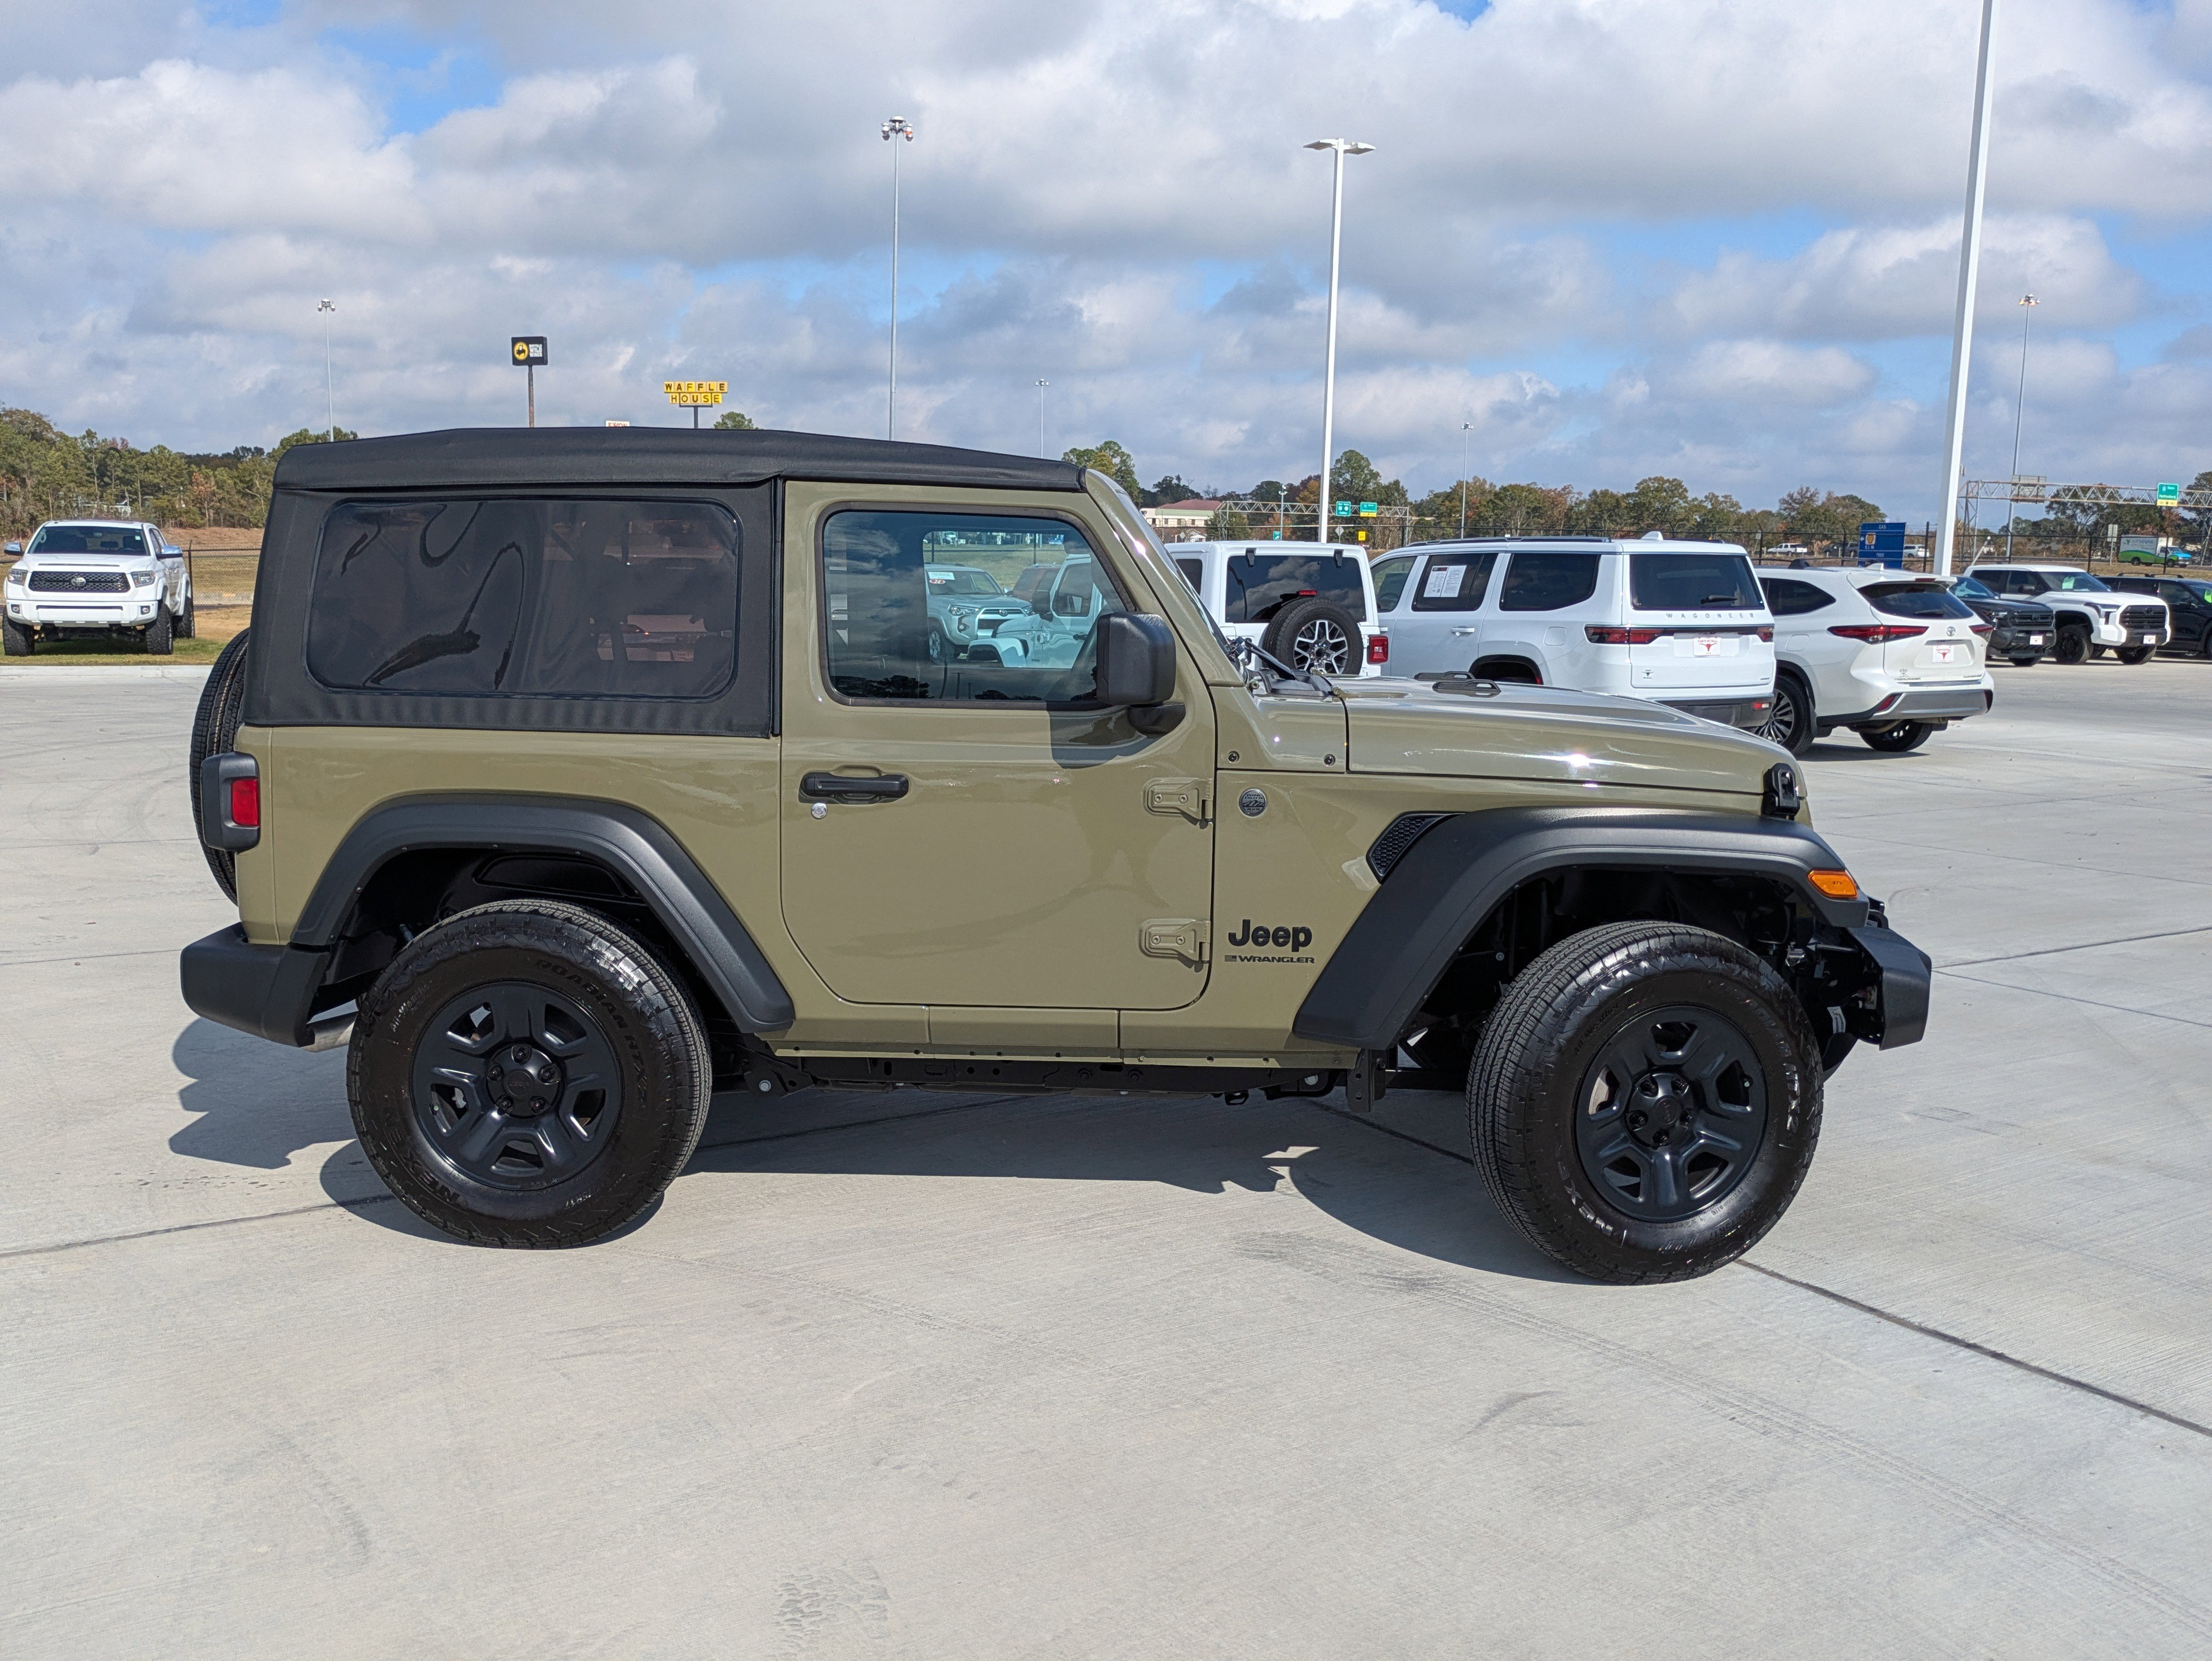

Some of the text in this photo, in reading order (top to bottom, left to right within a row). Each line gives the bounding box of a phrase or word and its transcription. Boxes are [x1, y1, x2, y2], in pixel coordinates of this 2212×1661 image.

[665, 383, 725, 391] WAFFLE
[671, 394, 720, 403] HOUSE
[1228, 919, 1312, 952] Jeep
[1238, 955, 1315, 963] WRANGLER
